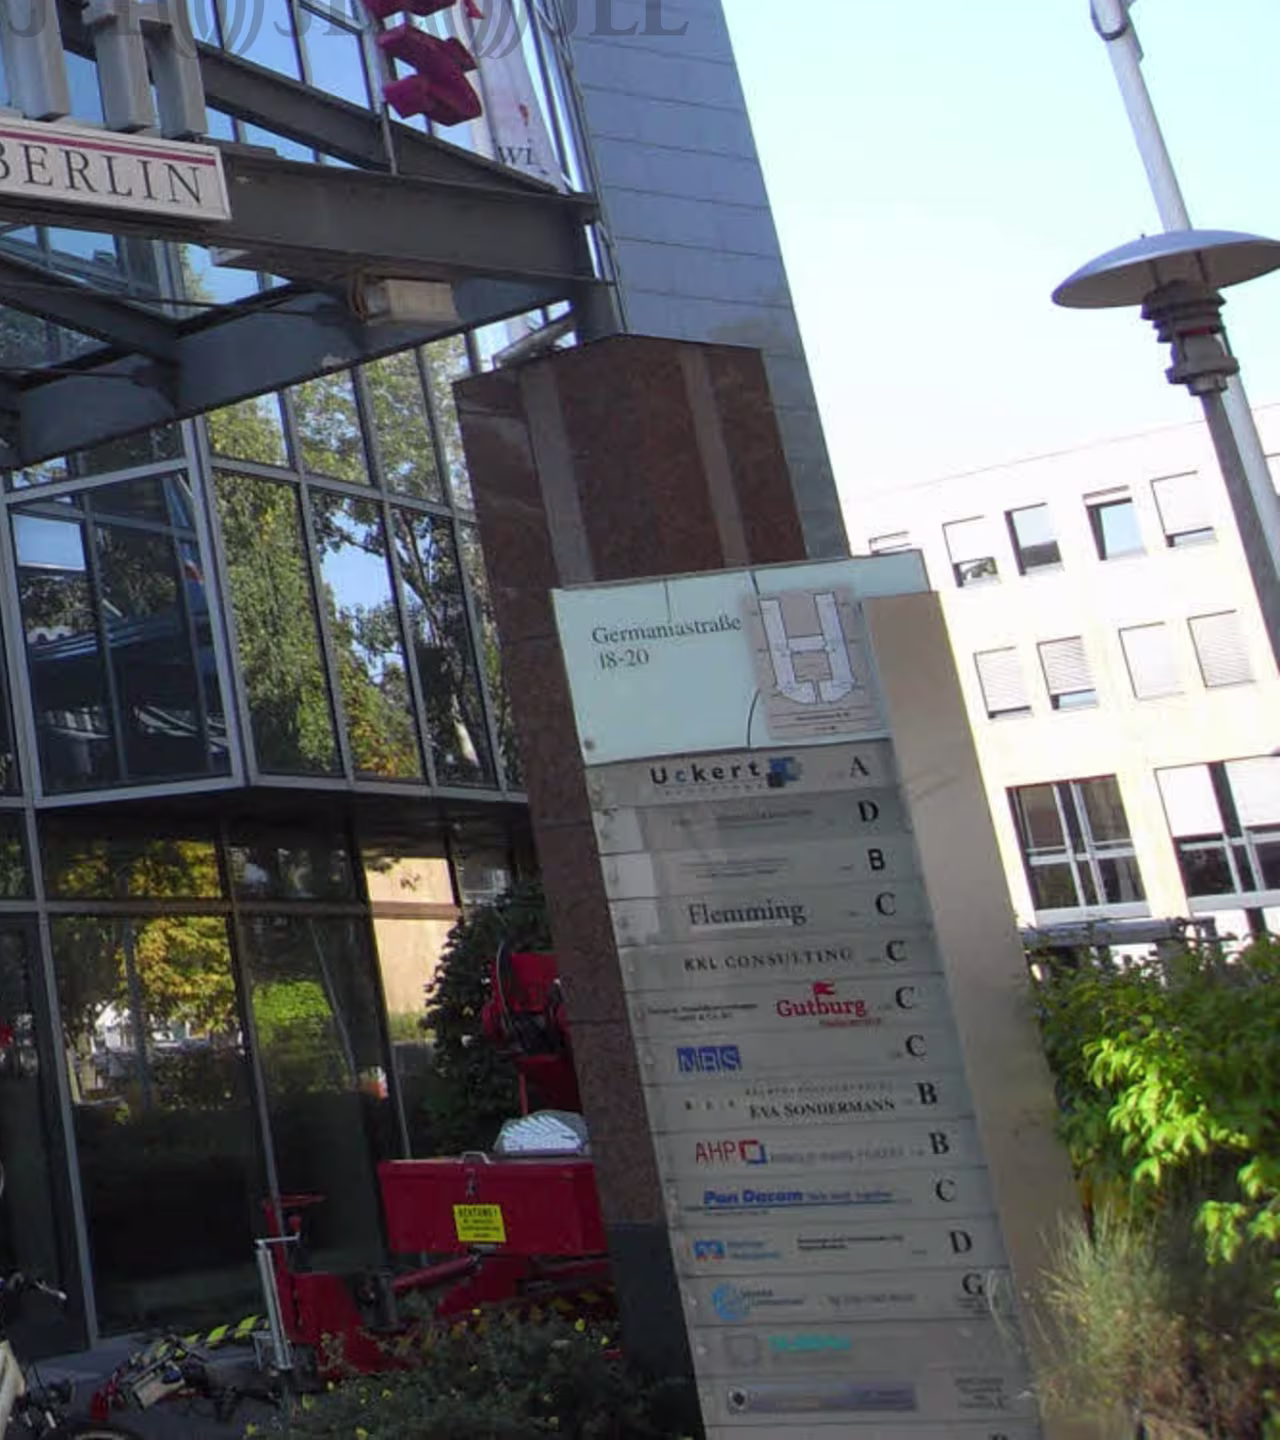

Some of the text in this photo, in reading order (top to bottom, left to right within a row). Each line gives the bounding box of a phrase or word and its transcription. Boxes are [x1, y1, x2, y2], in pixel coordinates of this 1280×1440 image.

[592, 614, 741, 645] Germaniastraße
[600, 647, 650, 671] 18-20
[650, 755, 870, 785] Uckert A
[856, 800, 880, 823] D
[867, 847, 887, 872] B
[688, 892, 897, 927] Flemming C
[724, 947, 852, 970] CONSULTING
[886, 940, 907, 962] C
[776, 994, 868, 1018] Gutburg
[895, 986, 915, 1010] C
[905, 1035, 928, 1058] C
[917, 1081, 938, 1106] B
[695, 1140, 737, 1164] AHP
[928, 1131, 950, 1155] B
[935, 1178, 956, 1203] C
[949, 1230, 973, 1255] D
[961, 1273, 985, 1297] G
